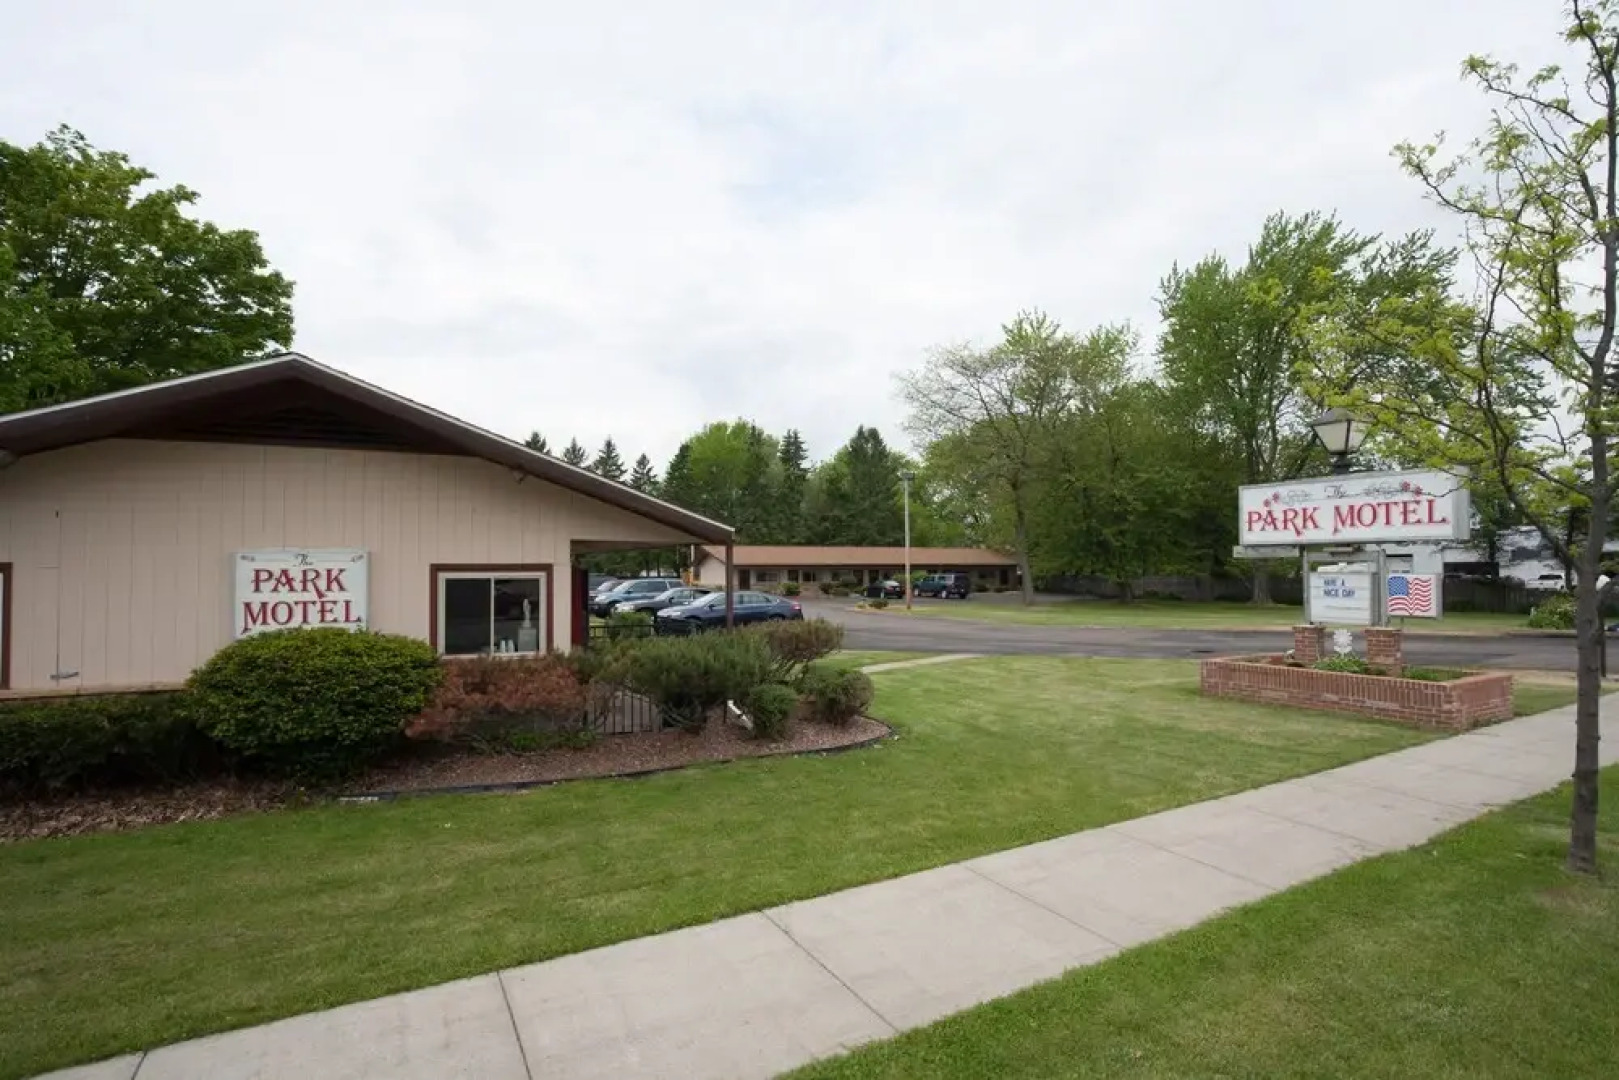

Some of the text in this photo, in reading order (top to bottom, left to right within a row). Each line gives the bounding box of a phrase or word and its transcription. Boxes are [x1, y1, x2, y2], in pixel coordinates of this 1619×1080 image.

[1246, 499, 1449, 537] PARK MOTEL
[251, 568, 347, 599] PARK
[1324, 589, 1356, 597] NICE DAY
[241, 600, 361, 635] MOTEL
